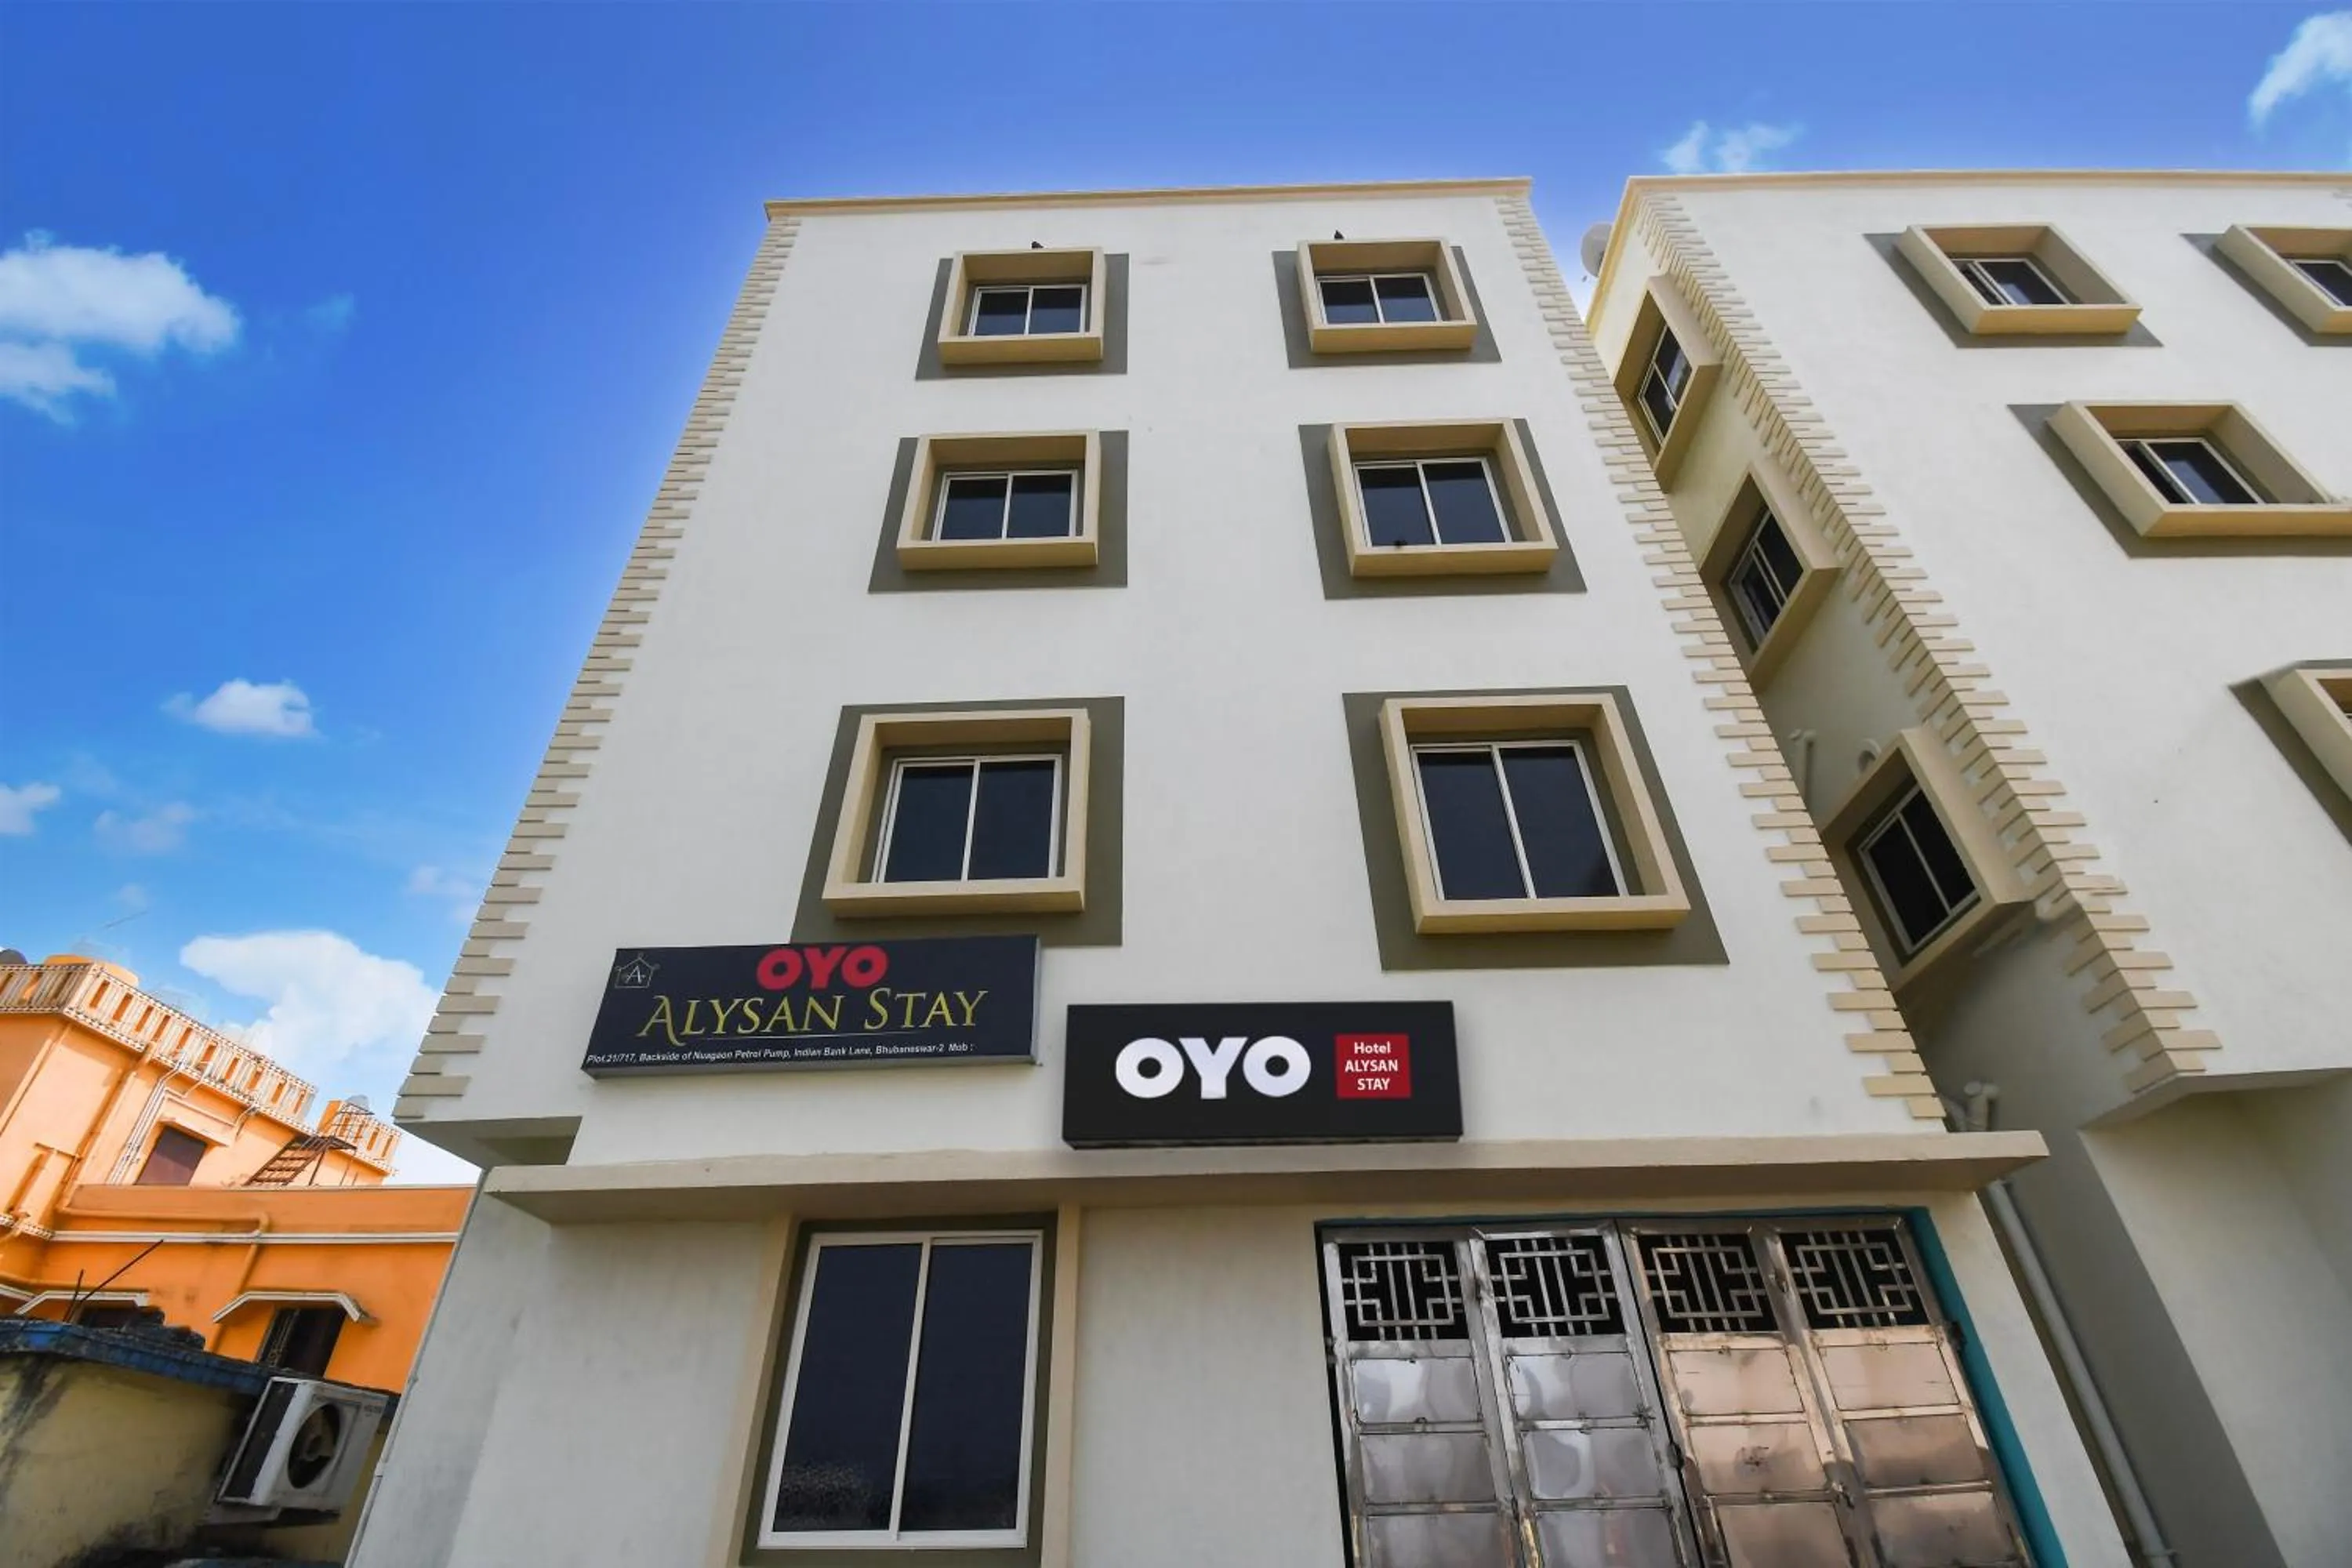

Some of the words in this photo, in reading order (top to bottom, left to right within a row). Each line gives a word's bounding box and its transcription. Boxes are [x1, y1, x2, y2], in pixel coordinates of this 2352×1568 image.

[757, 946, 889, 991] OYO
[636, 993, 845, 1047] ALYSAN
[863, 986, 989, 1032] STAY
[639, 1052, 679, 1062] Backside
[681, 1051, 692, 1061] of
[735, 1049, 761, 1059] Petrol
[764, 1048, 791, 1059] Pump,
[794, 1047, 822, 1058] Indian
[824, 1047, 846, 1056] Bank
[1353, 1040, 1392, 1054] Hotel
[1115, 1035, 1312, 1100] OYO
[1345, 1058, 1399, 1073] ALYSAN
[1356, 1077, 1391, 1091] STAY
